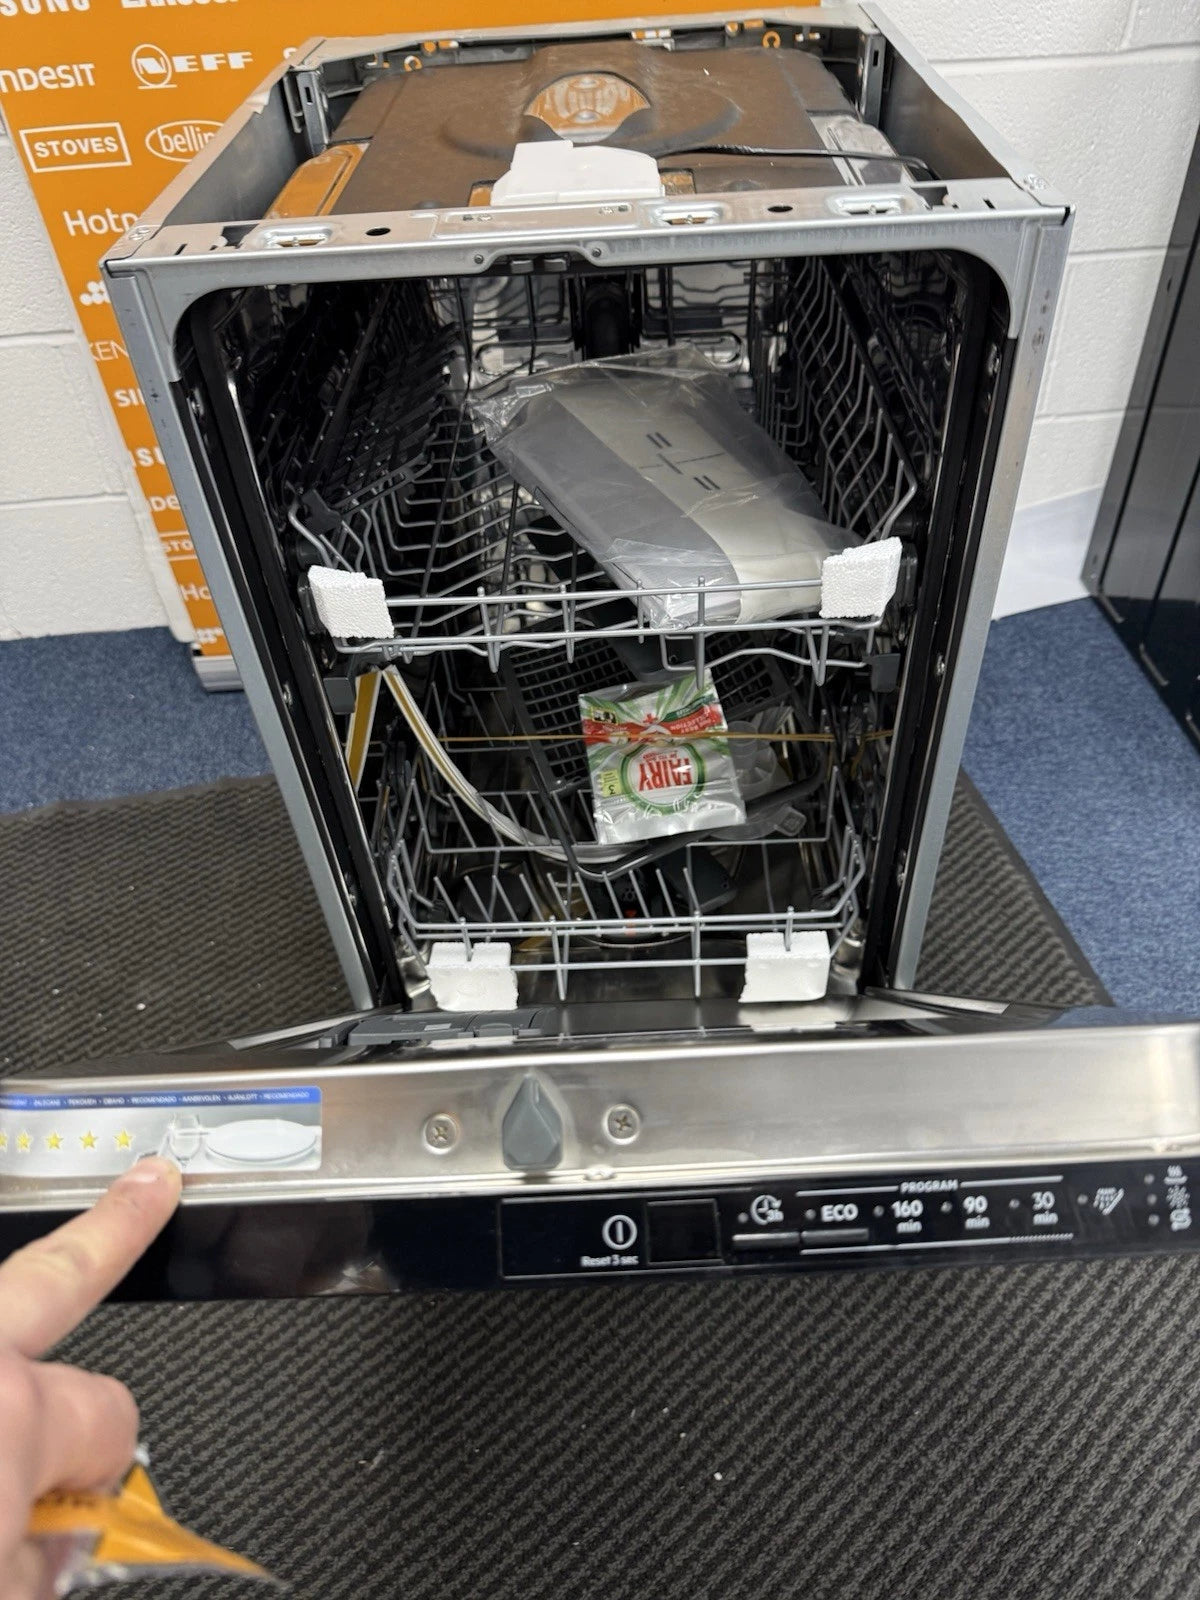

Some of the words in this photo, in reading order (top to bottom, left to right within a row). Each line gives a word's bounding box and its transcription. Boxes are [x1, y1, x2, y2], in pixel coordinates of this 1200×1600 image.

[136, 51, 253, 75] NEFF
[34, 137, 119, 158] STOVES
[638, 757, 693, 792] FAIRY
[900, 1178, 959, 1194] PROGRAM
[891, 1200, 924, 1218] 160
[963, 1195, 988, 1214] 90
[1031, 1191, 1055, 1210] 30
[821, 1203, 859, 1222] ECO
[1033, 1211, 1058, 1226] min
[896, 1219, 923, 1234] min
[965, 1214, 991, 1230] min
[581, 1255, 611, 1267] Reset
[620, 1255, 639, 1266] sec
